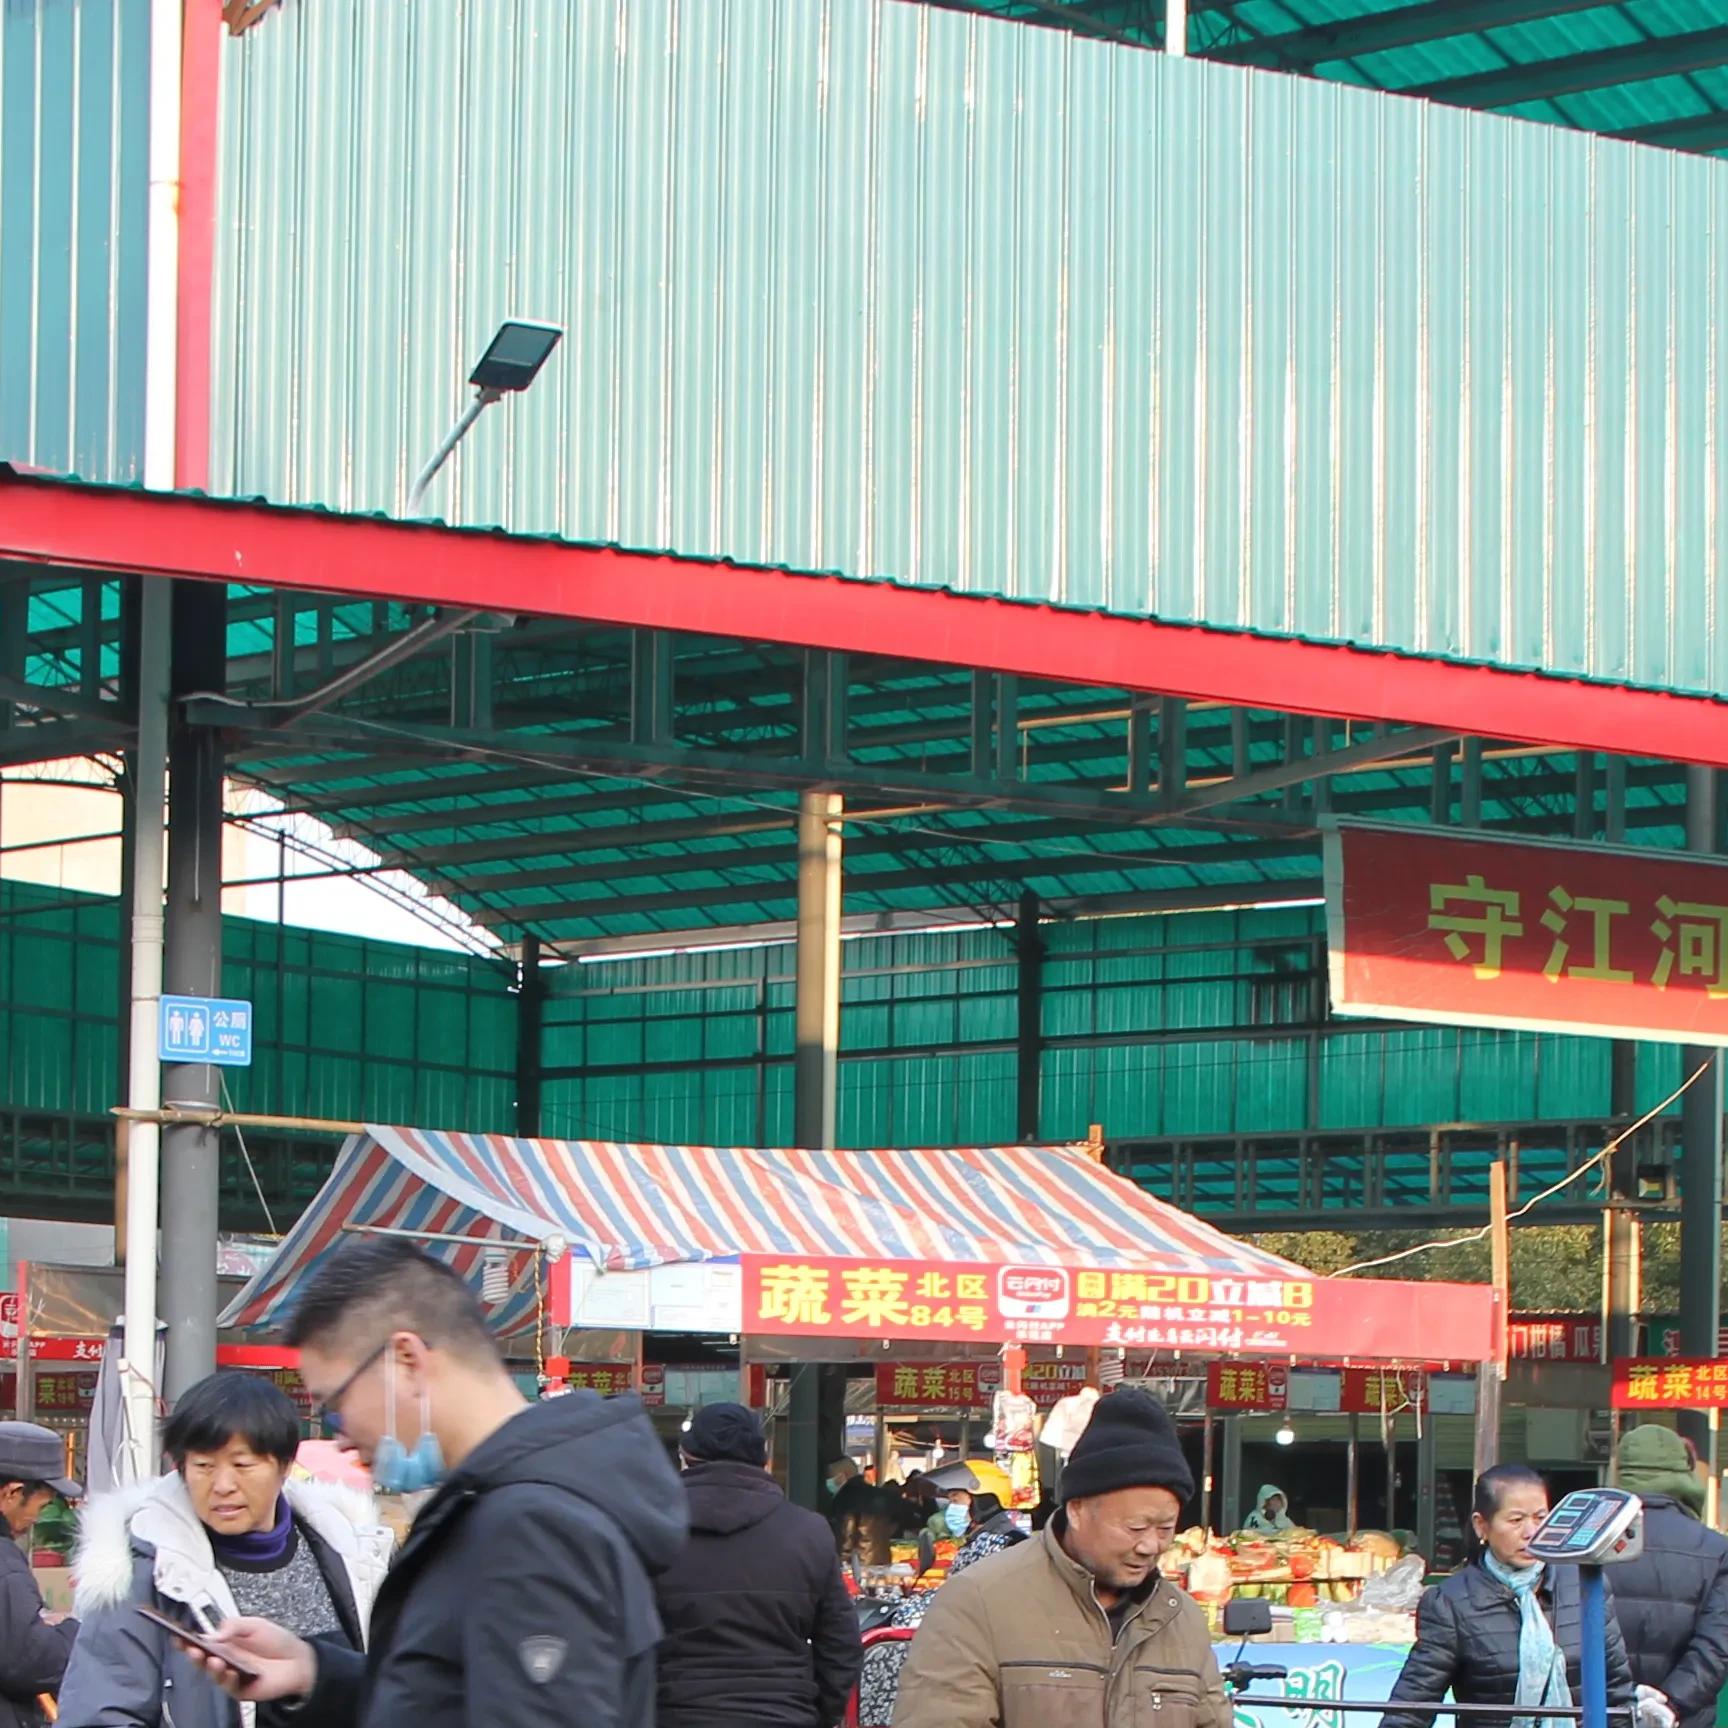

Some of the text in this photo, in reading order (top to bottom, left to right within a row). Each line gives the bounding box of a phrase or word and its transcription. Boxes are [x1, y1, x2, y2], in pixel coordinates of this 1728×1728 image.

[213, 1010, 247, 1031] 公厕
[219, 1034, 241, 1048] WC
[758, 1263, 990, 1328] 蔬菜 北区
[910, 1306, 989, 1331] 84号
[1506, 1324, 1567, 1360] 门柑橘
[892, 1366, 976, 1399] 蔬菜 北区
[1219, 1368, 1256, 1402] 蔬菜
[1627, 1363, 1728, 1401] 蔬菜 北区
[1695, 1384, 1728, 1401] 14号
